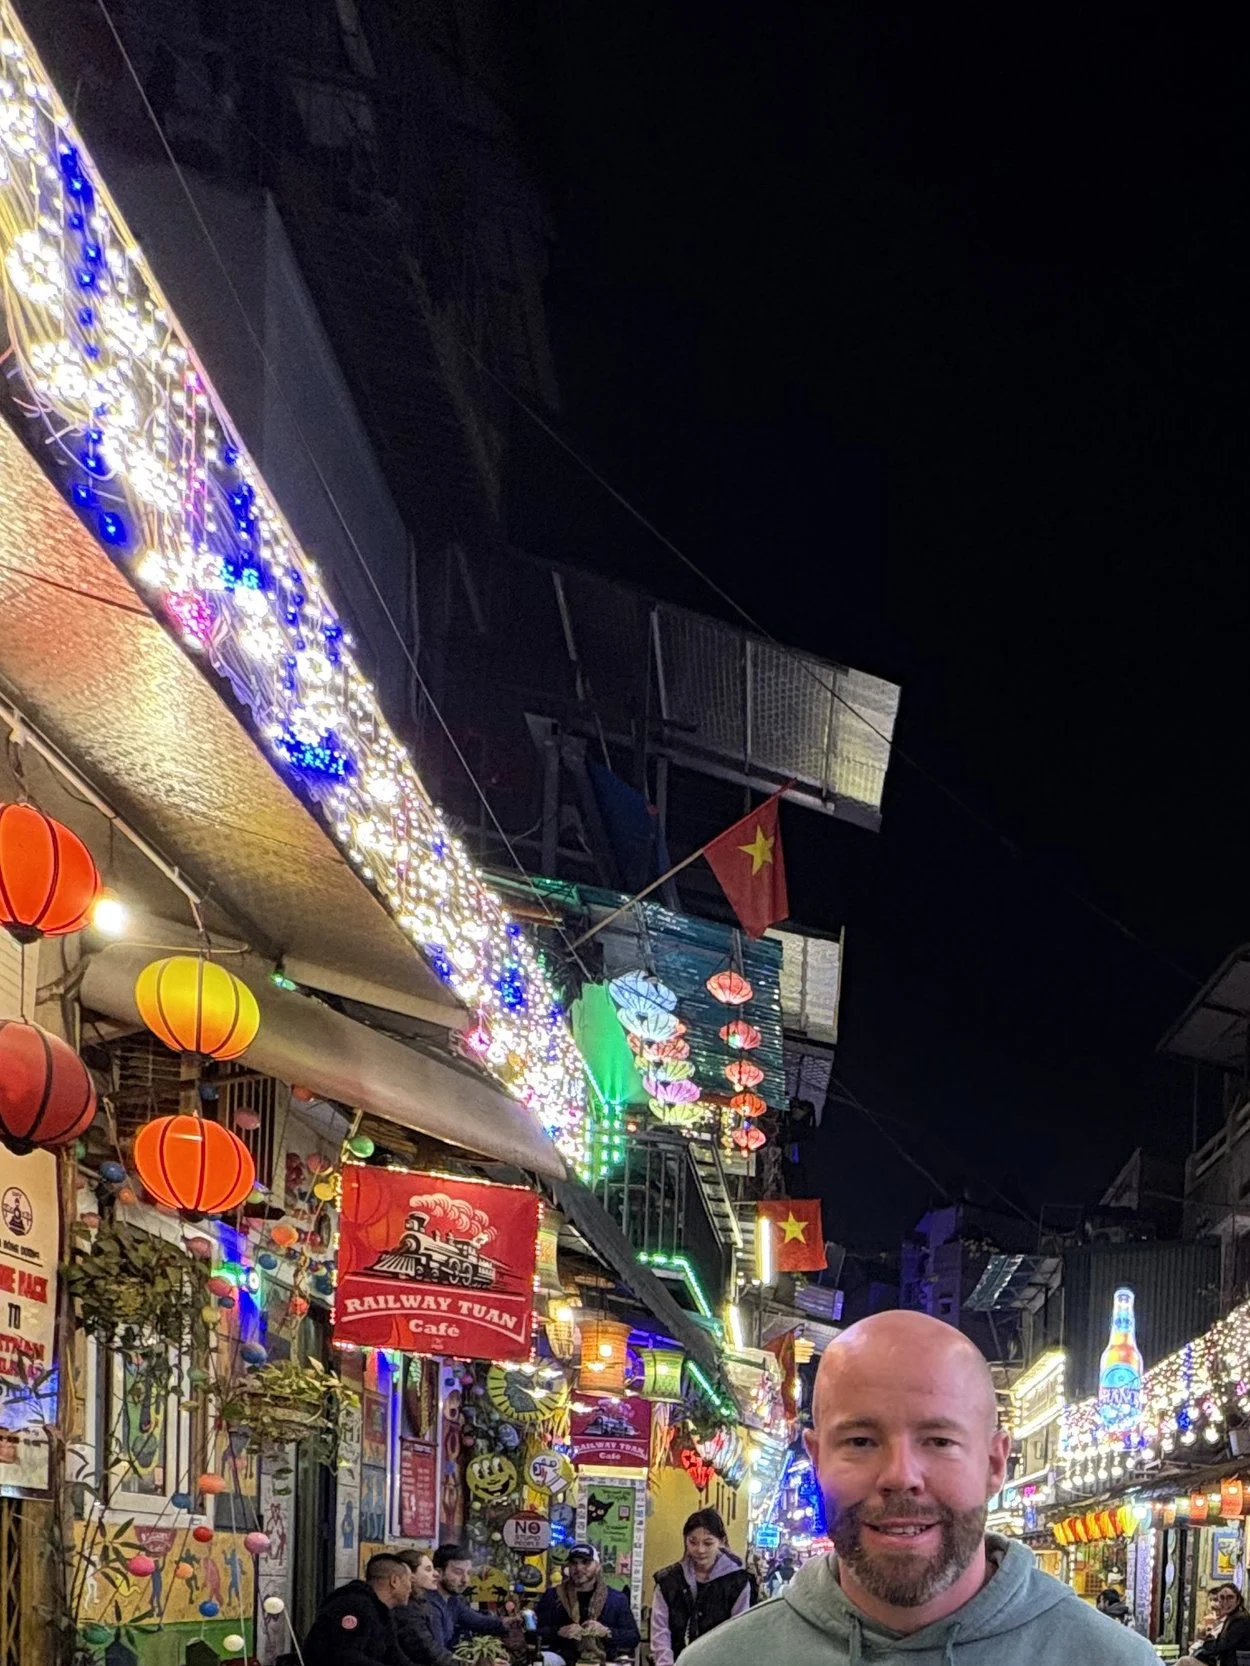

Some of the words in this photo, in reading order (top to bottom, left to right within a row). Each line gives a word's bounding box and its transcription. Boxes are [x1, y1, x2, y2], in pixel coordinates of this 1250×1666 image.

[8, 1302, 21, 1330] TO
[344, 1294, 453, 1314] RAILWAY
[458, 1300, 518, 1330] TUAN
[515, 1520, 541, 1535] NO
